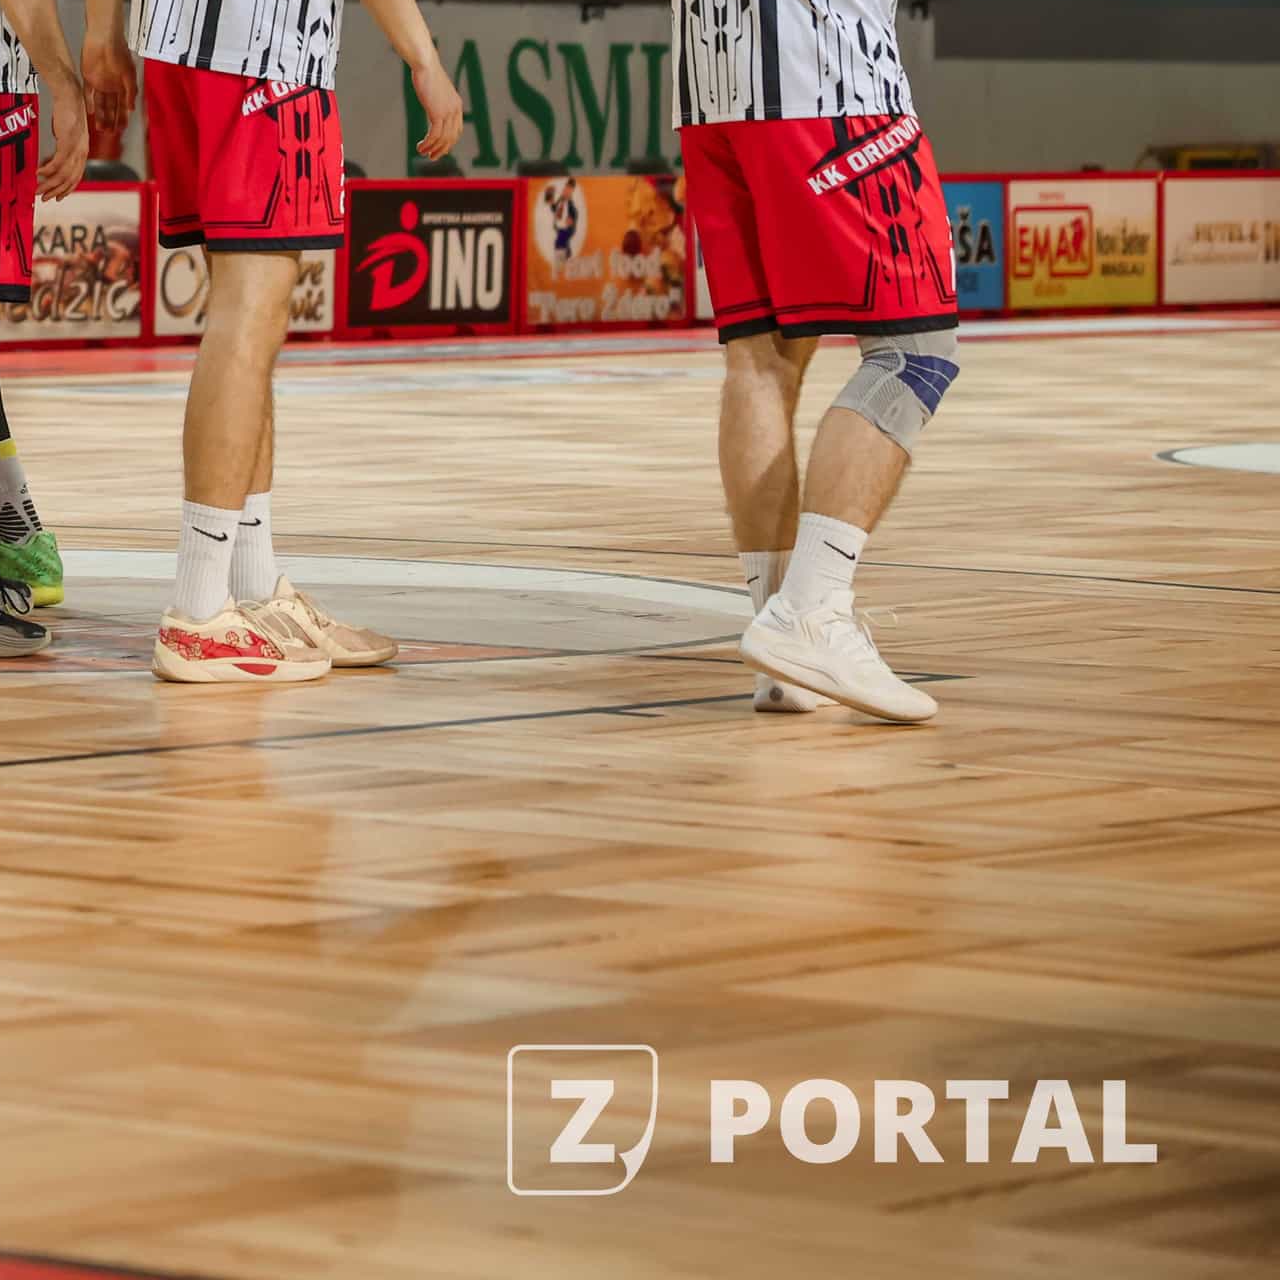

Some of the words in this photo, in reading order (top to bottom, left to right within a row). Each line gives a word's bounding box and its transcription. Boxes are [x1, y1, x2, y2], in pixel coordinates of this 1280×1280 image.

[241, 89, 269, 116] KK
[403, 37, 682, 175] ASMI
[807, 165, 848, 195] KK
